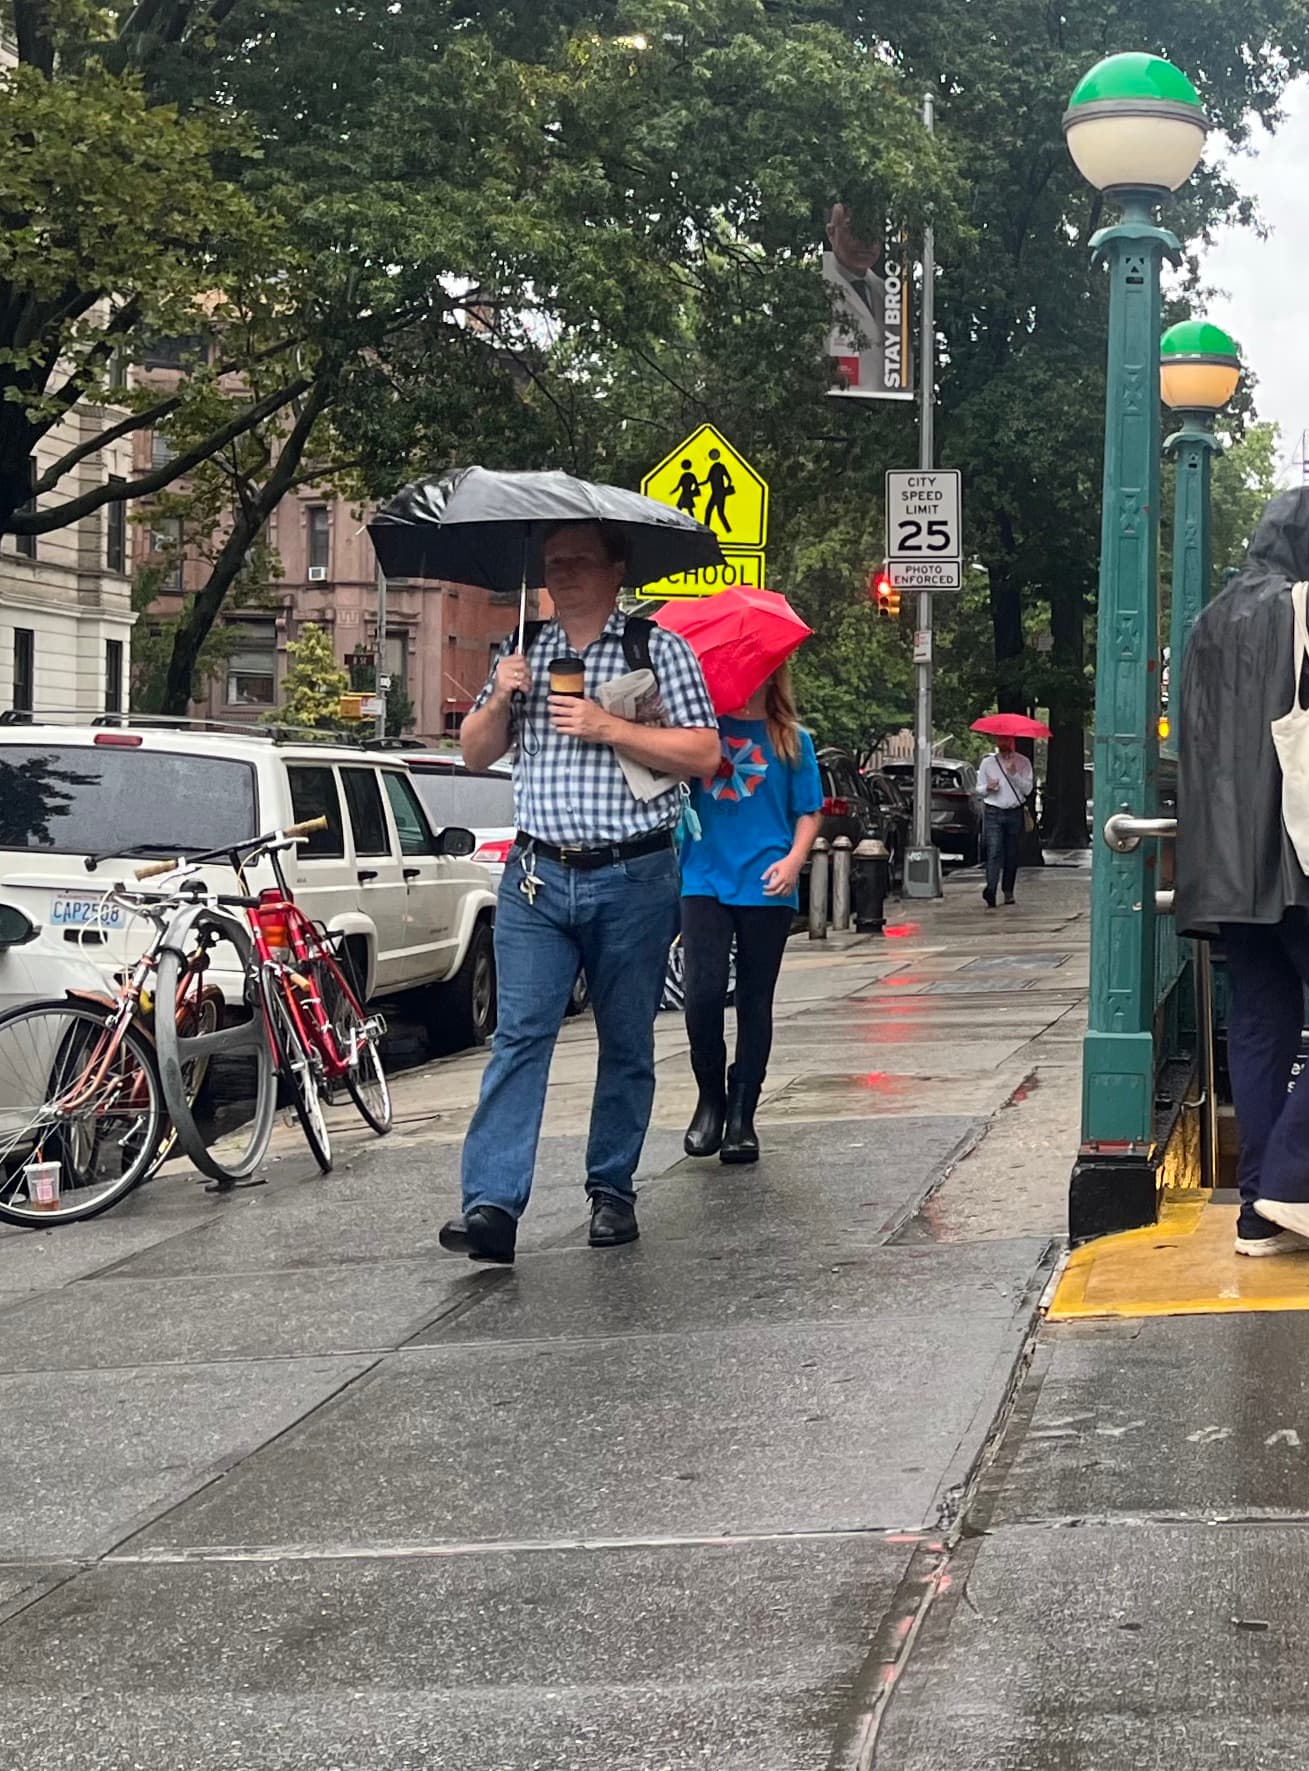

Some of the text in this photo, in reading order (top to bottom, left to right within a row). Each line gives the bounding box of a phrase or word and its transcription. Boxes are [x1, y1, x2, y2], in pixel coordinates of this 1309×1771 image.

[884, 331, 901, 388] STAY
[907, 477, 937, 488] CITY
[901, 490, 943, 501] SPEED
[906, 504, 939, 515] LIMIT
[897, 520, 951, 552] 25
[905, 565, 943, 575] PHOTO
[894, 575, 954, 585] ENFORCED
